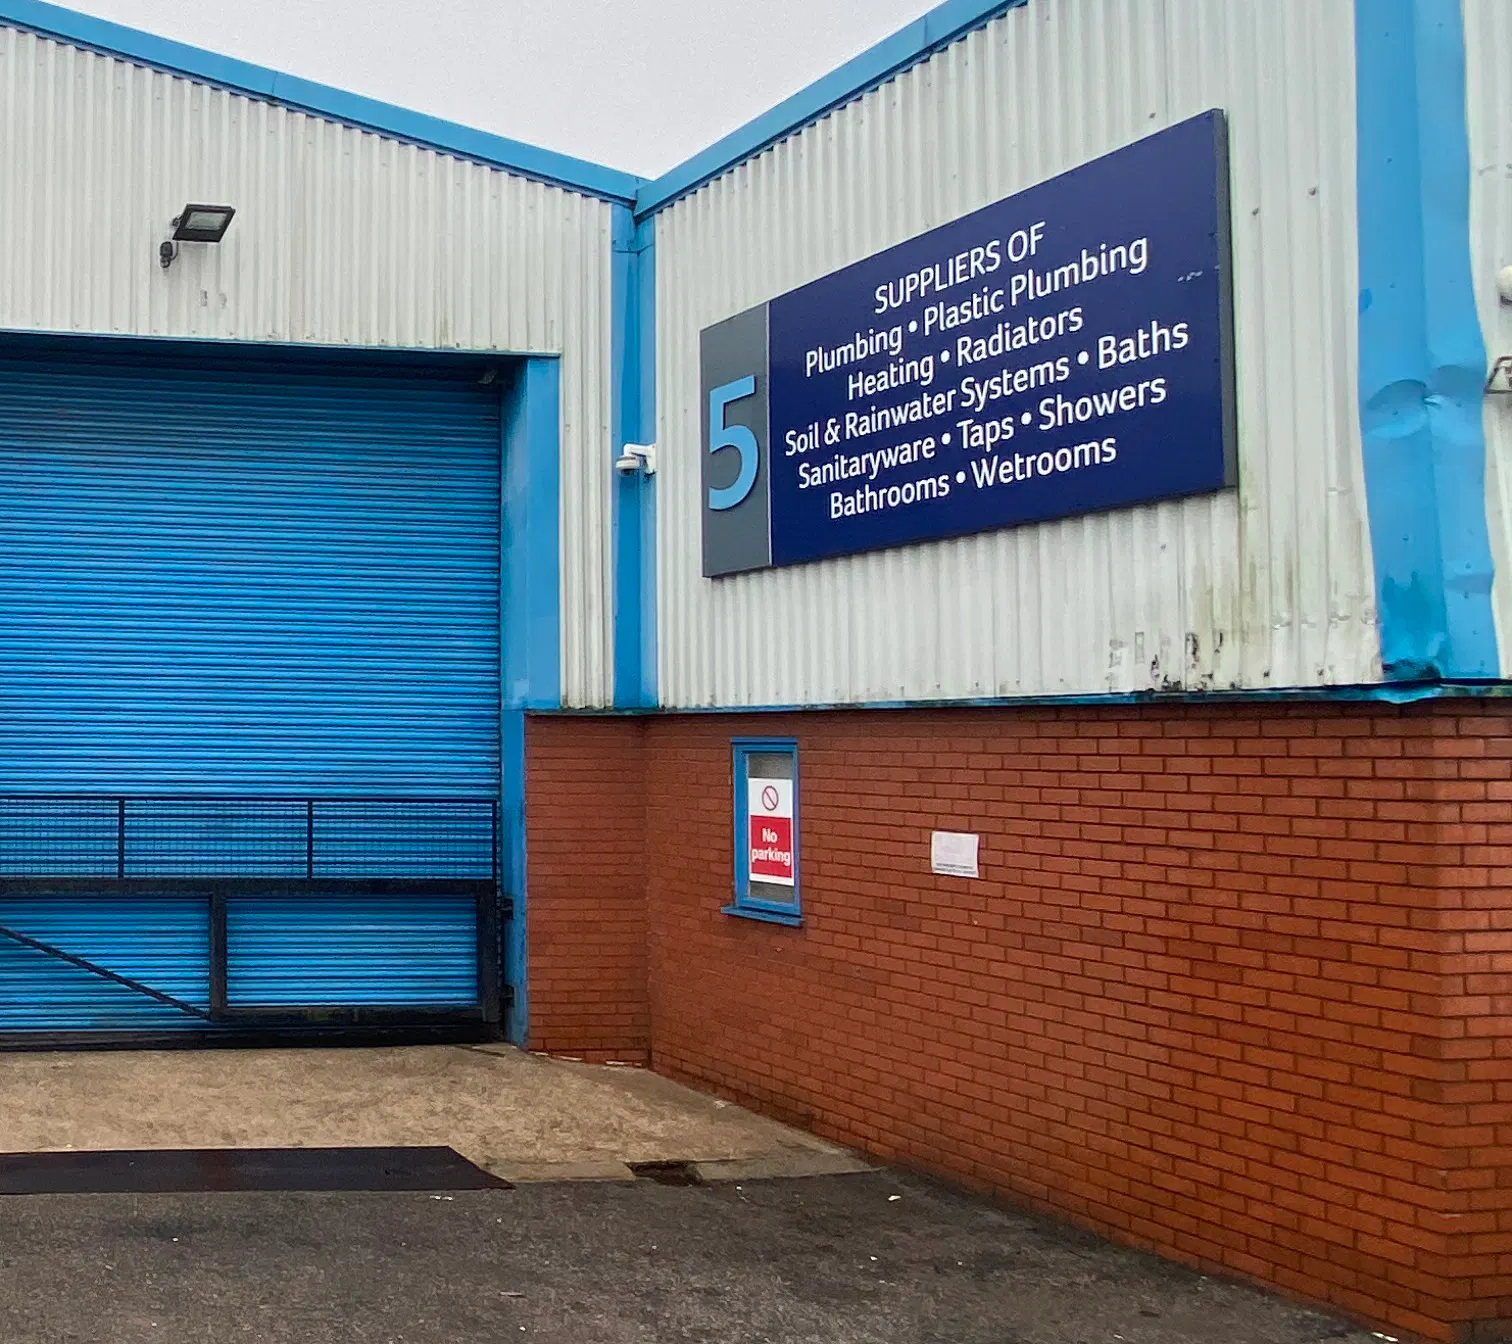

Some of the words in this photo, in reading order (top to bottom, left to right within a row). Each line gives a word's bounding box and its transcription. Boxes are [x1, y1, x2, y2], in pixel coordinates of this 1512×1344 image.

[806, 325, 903, 377] Plumbing
[924, 287, 1004, 336] Plastic
[1011, 237, 1148, 306] Plumbing
[875, 240, 1001, 314] SUPPLIERS
[1007, 221, 1046, 262] OF
[785, 421, 820, 456] Soil
[824, 417, 840, 446] &
[845, 389, 957, 440] Rainwater
[960, 356, 1070, 412] Systems
[1098, 320, 1189, 370] Baths
[848, 355, 934, 400] Heating
[957, 307, 1083, 367] Radiators
[708, 375, 760, 512] 5
[798, 435, 936, 489] Sanitaryware
[956, 416, 1014, 452] Taps
[1039, 377, 1167, 431] Showers
[830, 474, 950, 519] Bathrooms
[971, 437, 1117, 488] Wetrooms
[751, 847, 791, 866] parking
[762, 827, 778, 843] No
